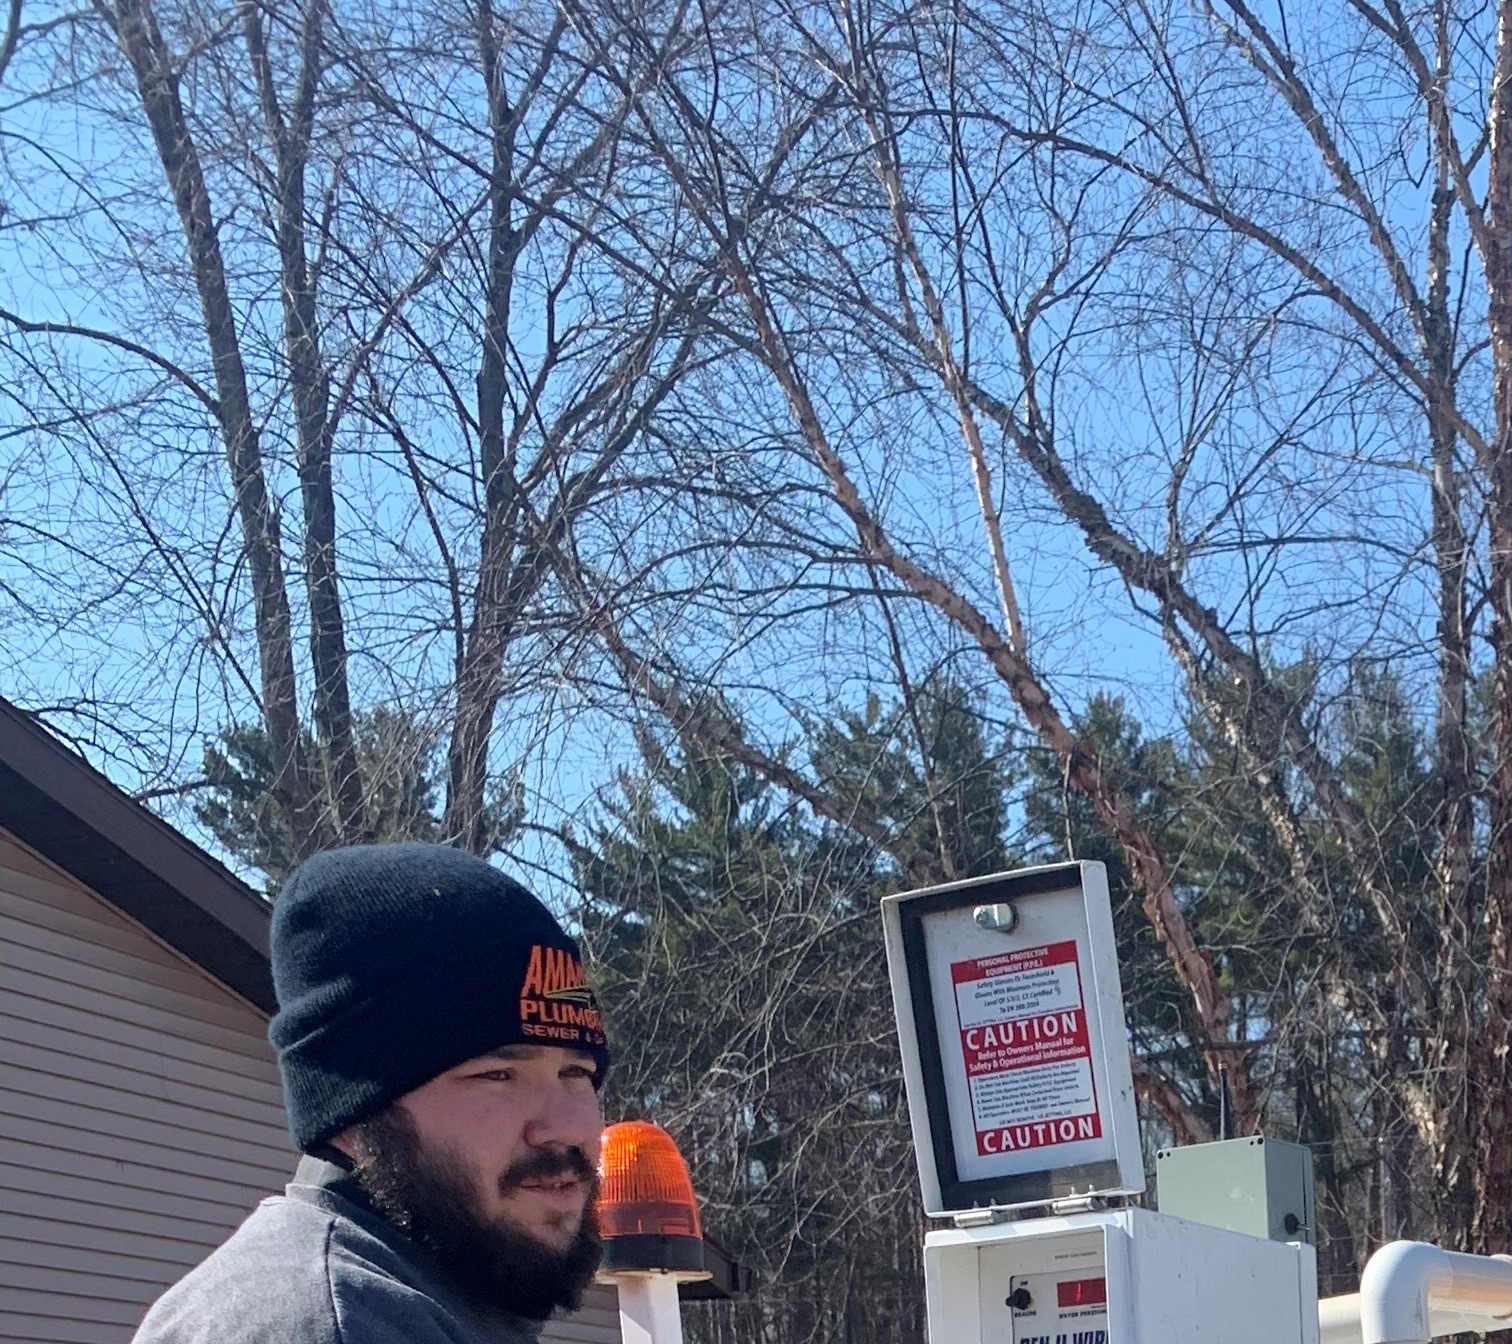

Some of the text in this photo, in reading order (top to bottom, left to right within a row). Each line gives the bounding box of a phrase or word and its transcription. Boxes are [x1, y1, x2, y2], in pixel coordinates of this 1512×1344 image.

[522, 1023, 580, 1041] SEWER
[966, 1012, 1078, 1051] CAUTION
[969, 1060, 992, 1073] Safety
[999, 1051, 1041, 1067] Operational
[1042, 1045, 1087, 1060] Information
[977, 1036, 1074, 1061] Refer to Owners Manual for
[983, 1116, 1095, 1152] CAUTION
